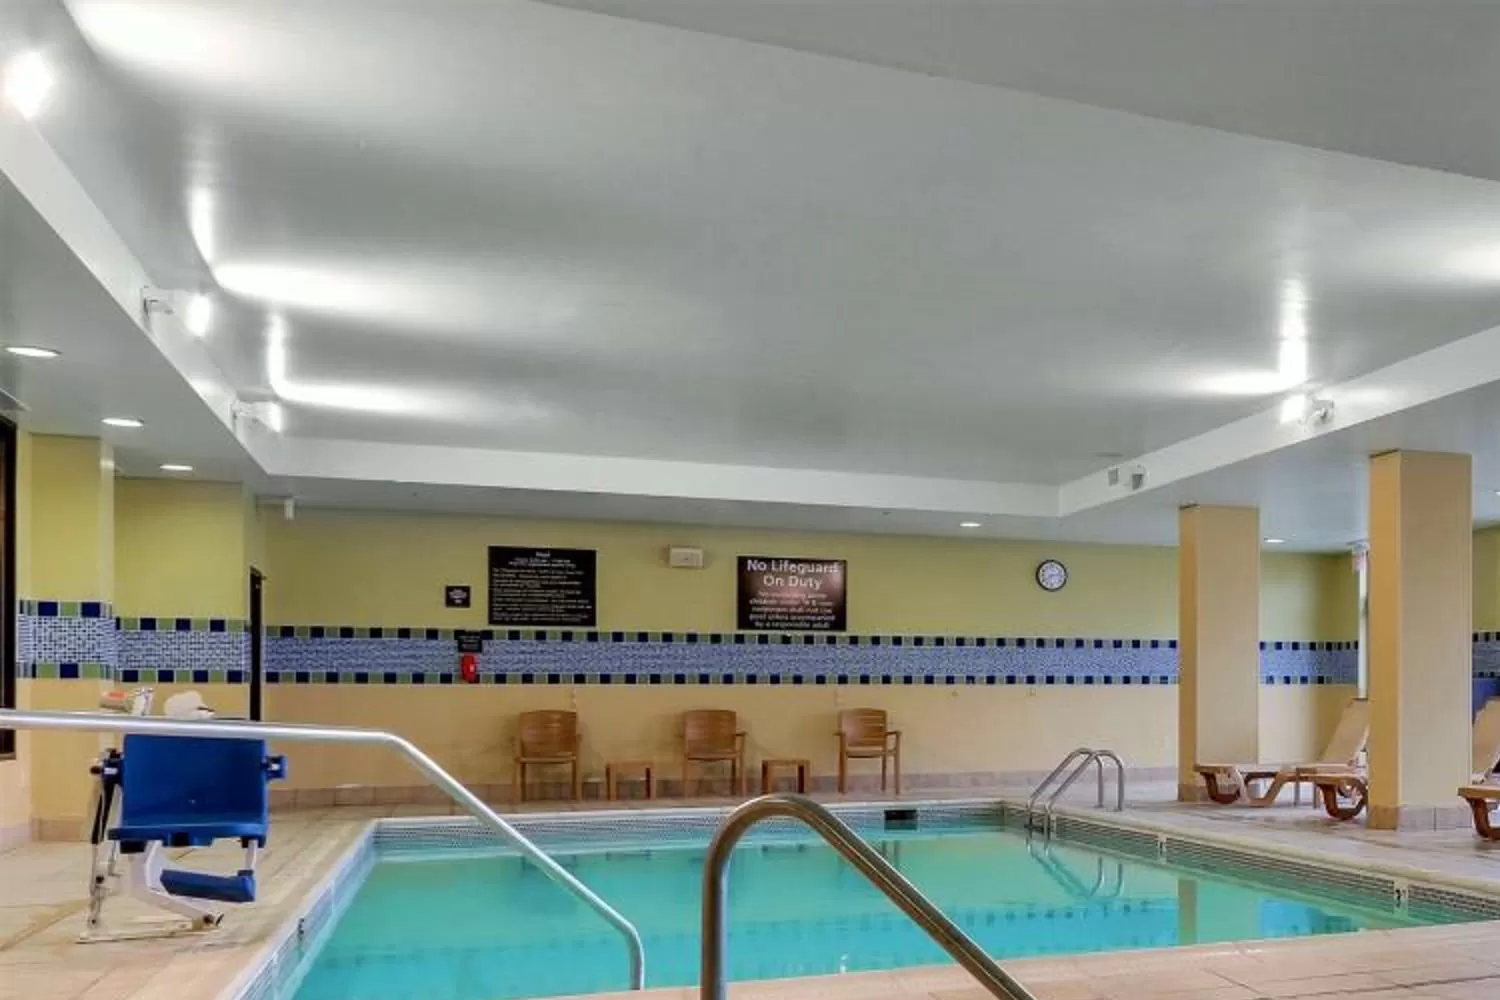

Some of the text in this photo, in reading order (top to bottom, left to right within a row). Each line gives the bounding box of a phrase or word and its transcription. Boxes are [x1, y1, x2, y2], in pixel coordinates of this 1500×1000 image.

[747, 559, 841, 575] No Lifeguard
[763, 574, 823, 591] On Duty
